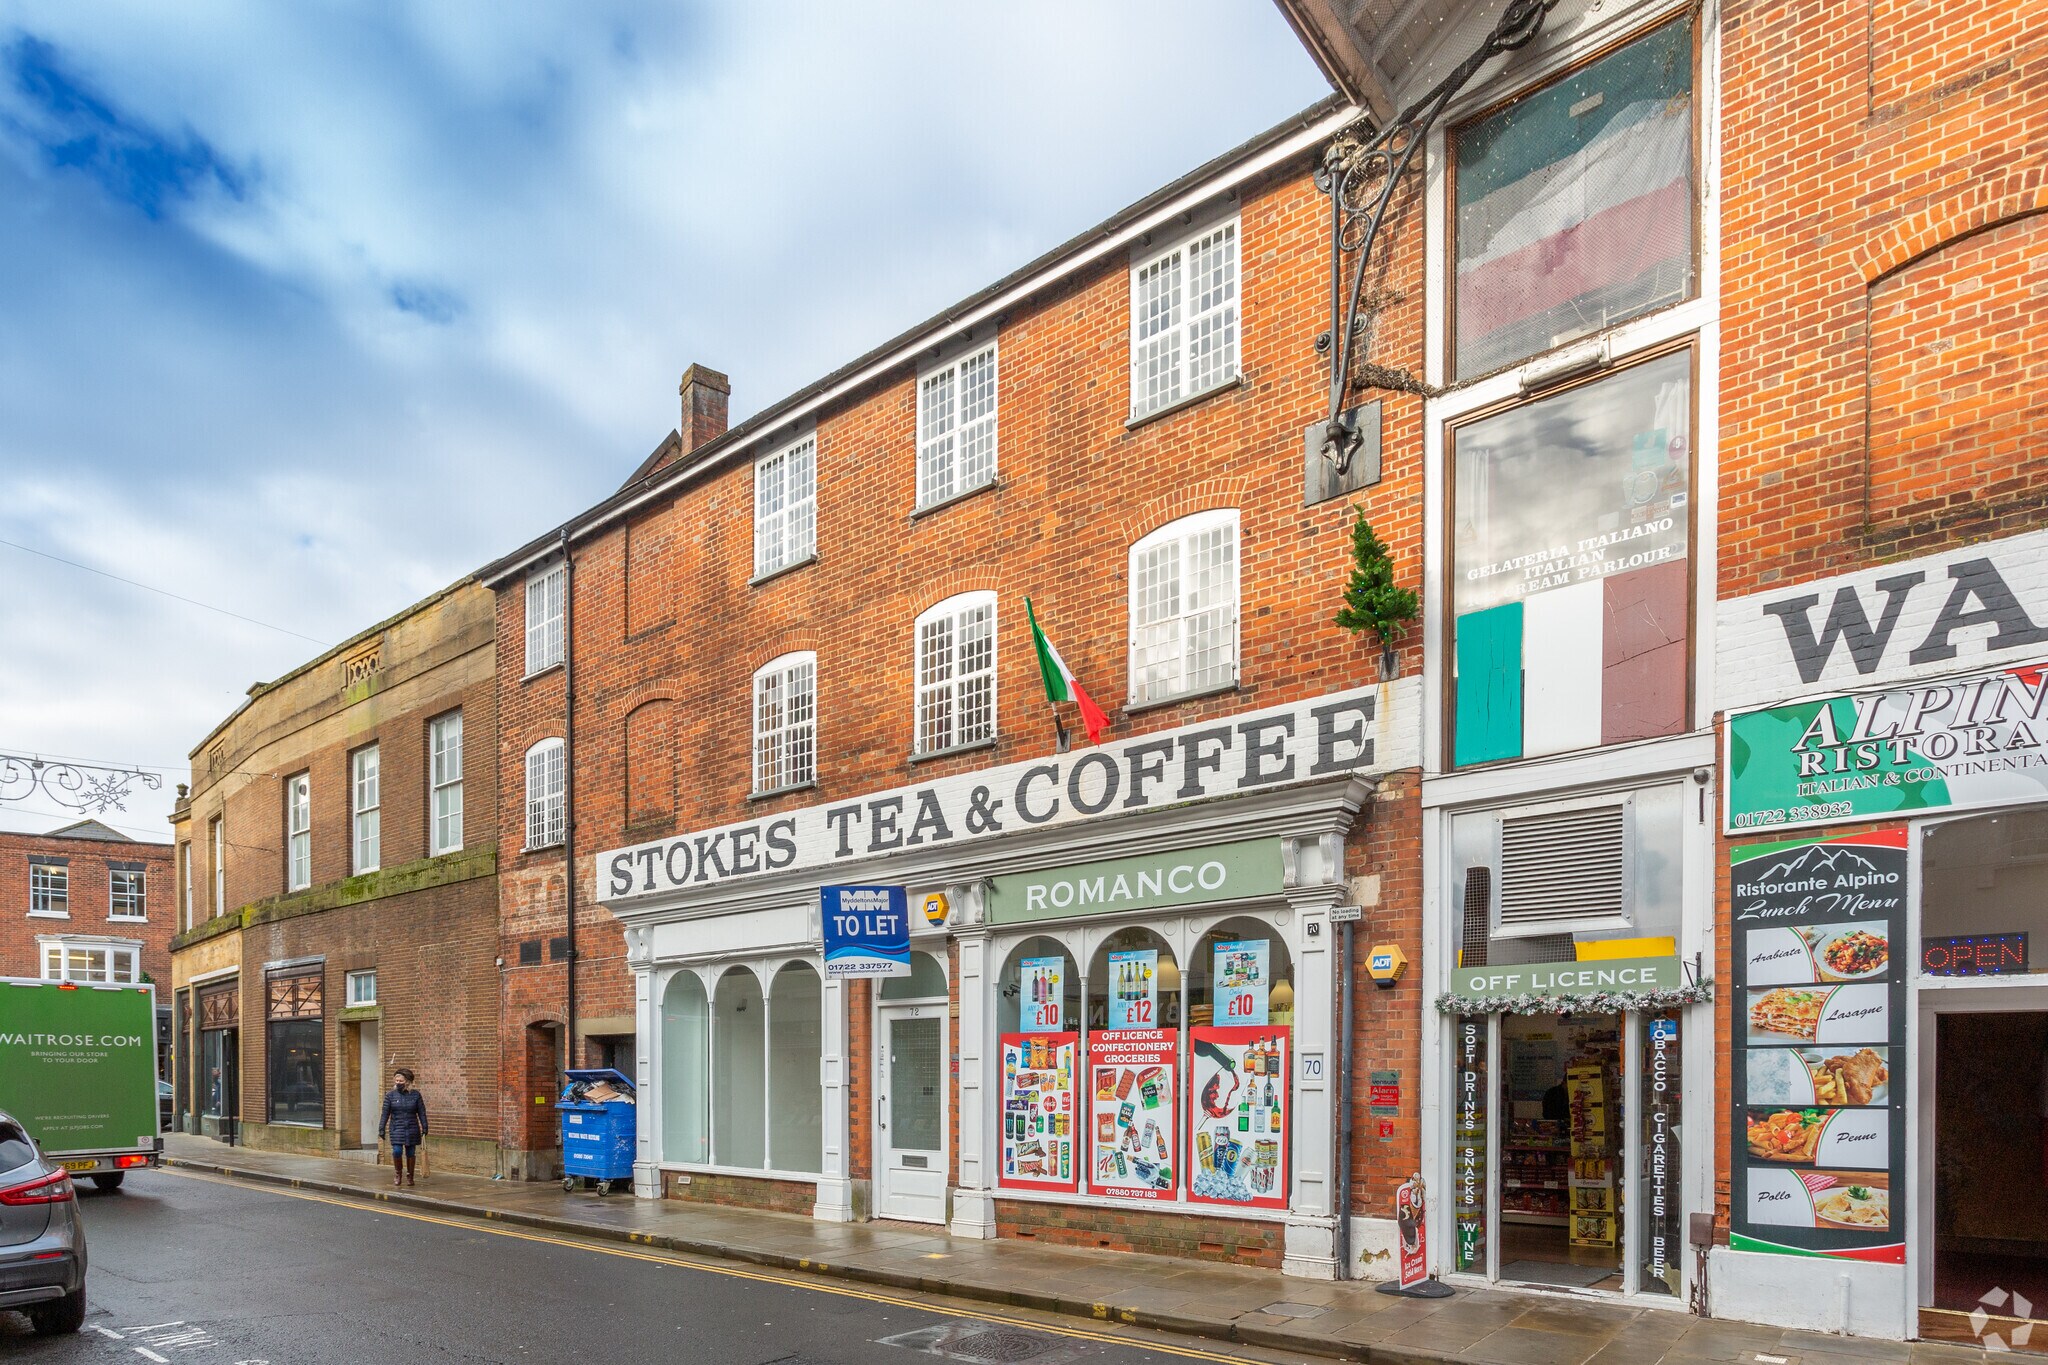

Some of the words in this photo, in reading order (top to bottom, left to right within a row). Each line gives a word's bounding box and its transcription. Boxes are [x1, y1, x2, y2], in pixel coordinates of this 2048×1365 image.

[1467, 545, 1570, 581] GELATERIA
[1577, 517, 1674, 552] ITALIANO
[1504, 572, 1570, 597] CREAM
[1577, 546, 1672, 580] PARLOUR
[1524, 548, 1606, 580] ITALIAN
[1763, 557, 2048, 684] WA
[1797, 773, 1880, 798] ITALIAN
[1883, 772, 1901, 787] &
[1904, 752, 2048, 784] CONTINENTA
[610, 817, 798, 897] STOKES
[826, 787, 954, 859] TEA
[965, 785, 1003, 835] &
[1015, 694, 1375, 824] COFFEE
[1736, 808, 1786, 828] 01722
[1790, 801, 1853, 821] 338932
[1026, 860, 1228, 912] ROMANCO
[1736, 876, 1828, 898] Ristorante
[1833, 870, 1899, 890] Alpino
[926, 901, 938, 911] ADT
[1737, 895, 1813, 921] Lunch
[1815, 892, 1900, 916] Menu
[833, 915, 860, 936] TO
[865, 915, 899, 936] LET
[1309, 924, 1318, 934] 70
[828, 963, 856, 971] 01722
[859, 962, 893, 970] 337577
[1372, 958, 1391, 968] ADT
[1749, 948, 1803, 965] Arabiata
[1925, 942, 2023, 968] OPEN
[1469, 974, 1522, 992] OFF
[1532, 967, 1657, 988] LICENCE
[909, 1008, 920, 1016] 72
[1036, 1003, 1059, 1026] £10
[1127, 1000, 1152, 1023] £12
[1228, 993, 1254, 1016] £10
[1825, 1003, 1884, 1022] Lasagne
[0, 1033, 142, 1047] WAITROSE.COM
[1091, 1041, 1175, 1053] CONFECTIONERY
[1101, 1032, 1121, 1041] OFF
[1122, 1030, 1163, 1040] LICENCE
[1465, 1024, 1476, 1064] SOFT
[1104, 1053, 1161, 1064] GROCERIES
[1653, 1019, 1666, 1092] TOBACCO
[1304, 1060, 1321, 1076] 70
[1464, 1071, 1476, 1130] DRINKS
[1836, 1130, 1878, 1144] Penne
[62, 1162, 77, 1170] 69
[78, 1161, 94, 1169] PFJ
[1653, 1112, 1666, 1217] CIGARETTES
[1465, 1148, 1475, 1205] SNACKS
[1106, 1188, 1130, 1196] 07880
[1757, 1189, 1792, 1203] Pollo
[1463, 1222, 1477, 1261] WINE
[1653, 1237, 1665, 1279] BEER
